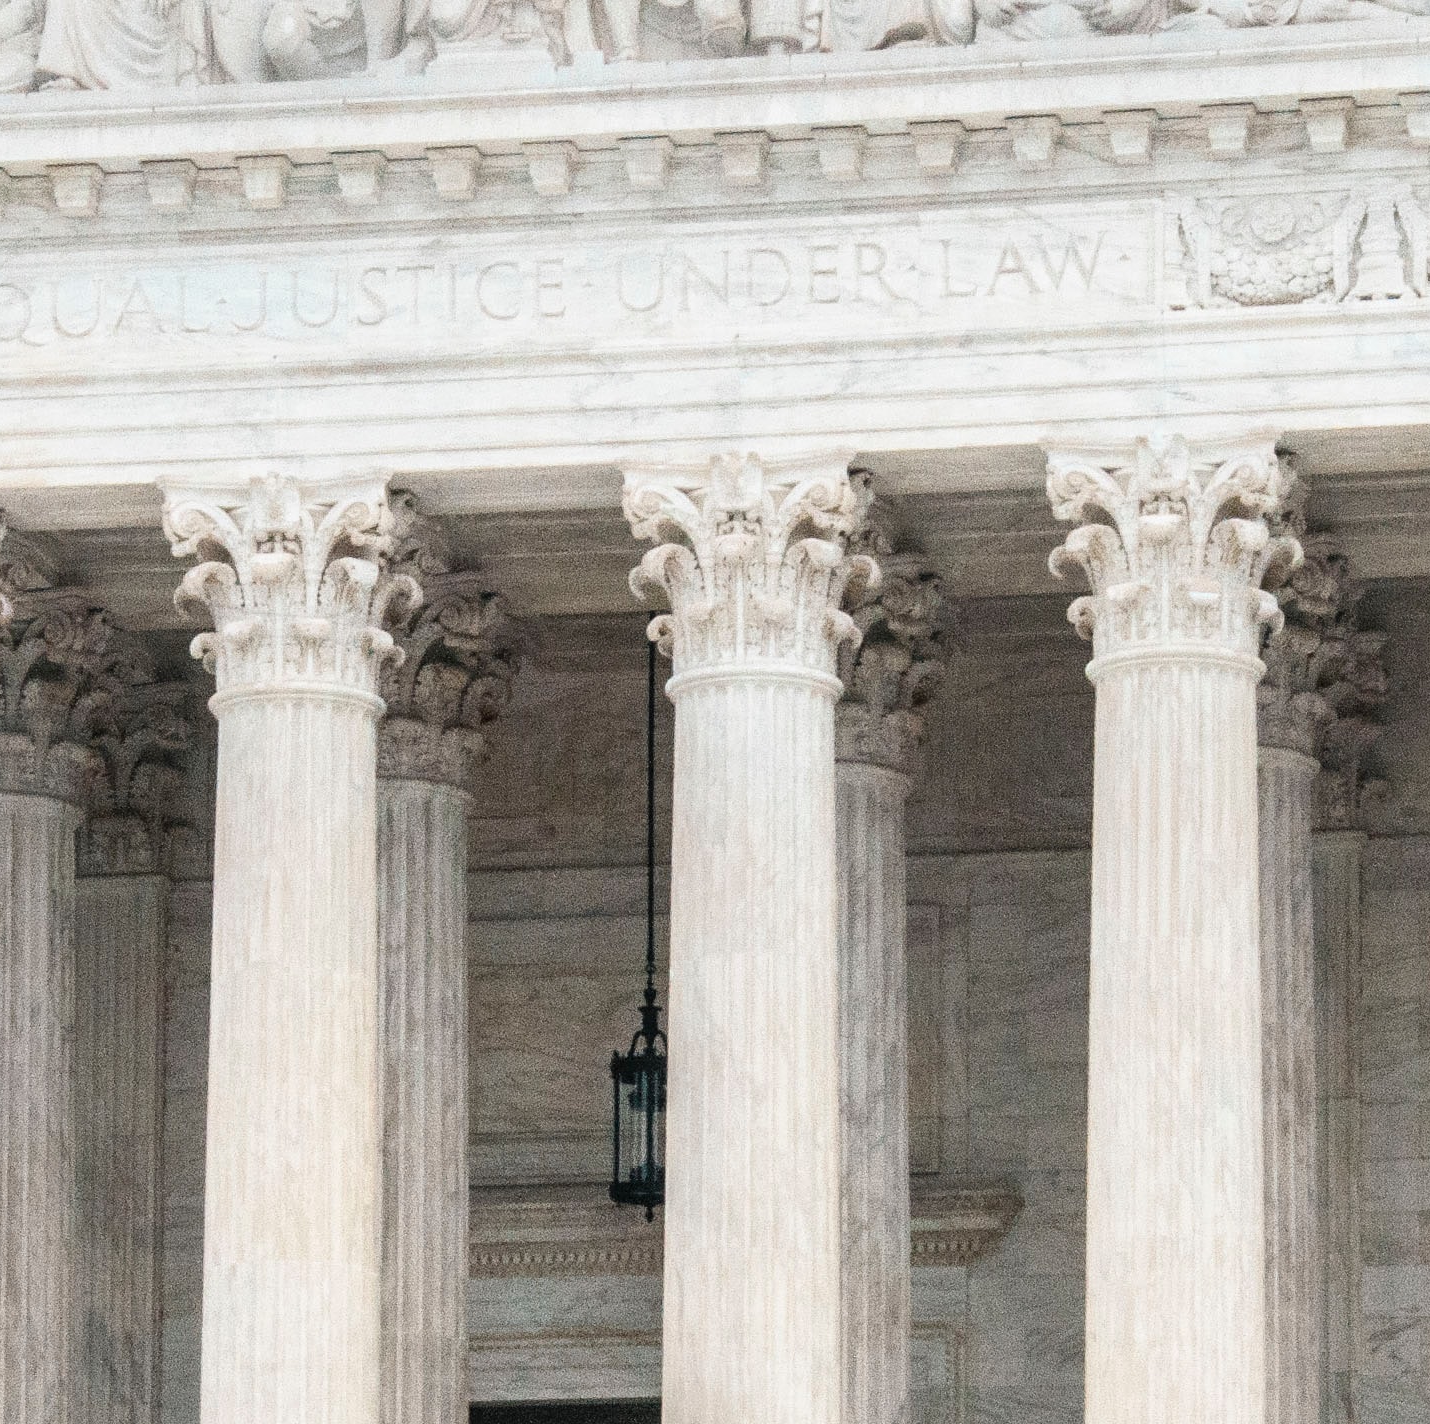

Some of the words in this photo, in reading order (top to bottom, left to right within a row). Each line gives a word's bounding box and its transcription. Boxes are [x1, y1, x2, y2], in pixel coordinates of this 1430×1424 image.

[230, 255, 568, 331] JUSTICE
[617, 239, 919, 314] UNDER
[938, 230, 1108, 299] LAW
